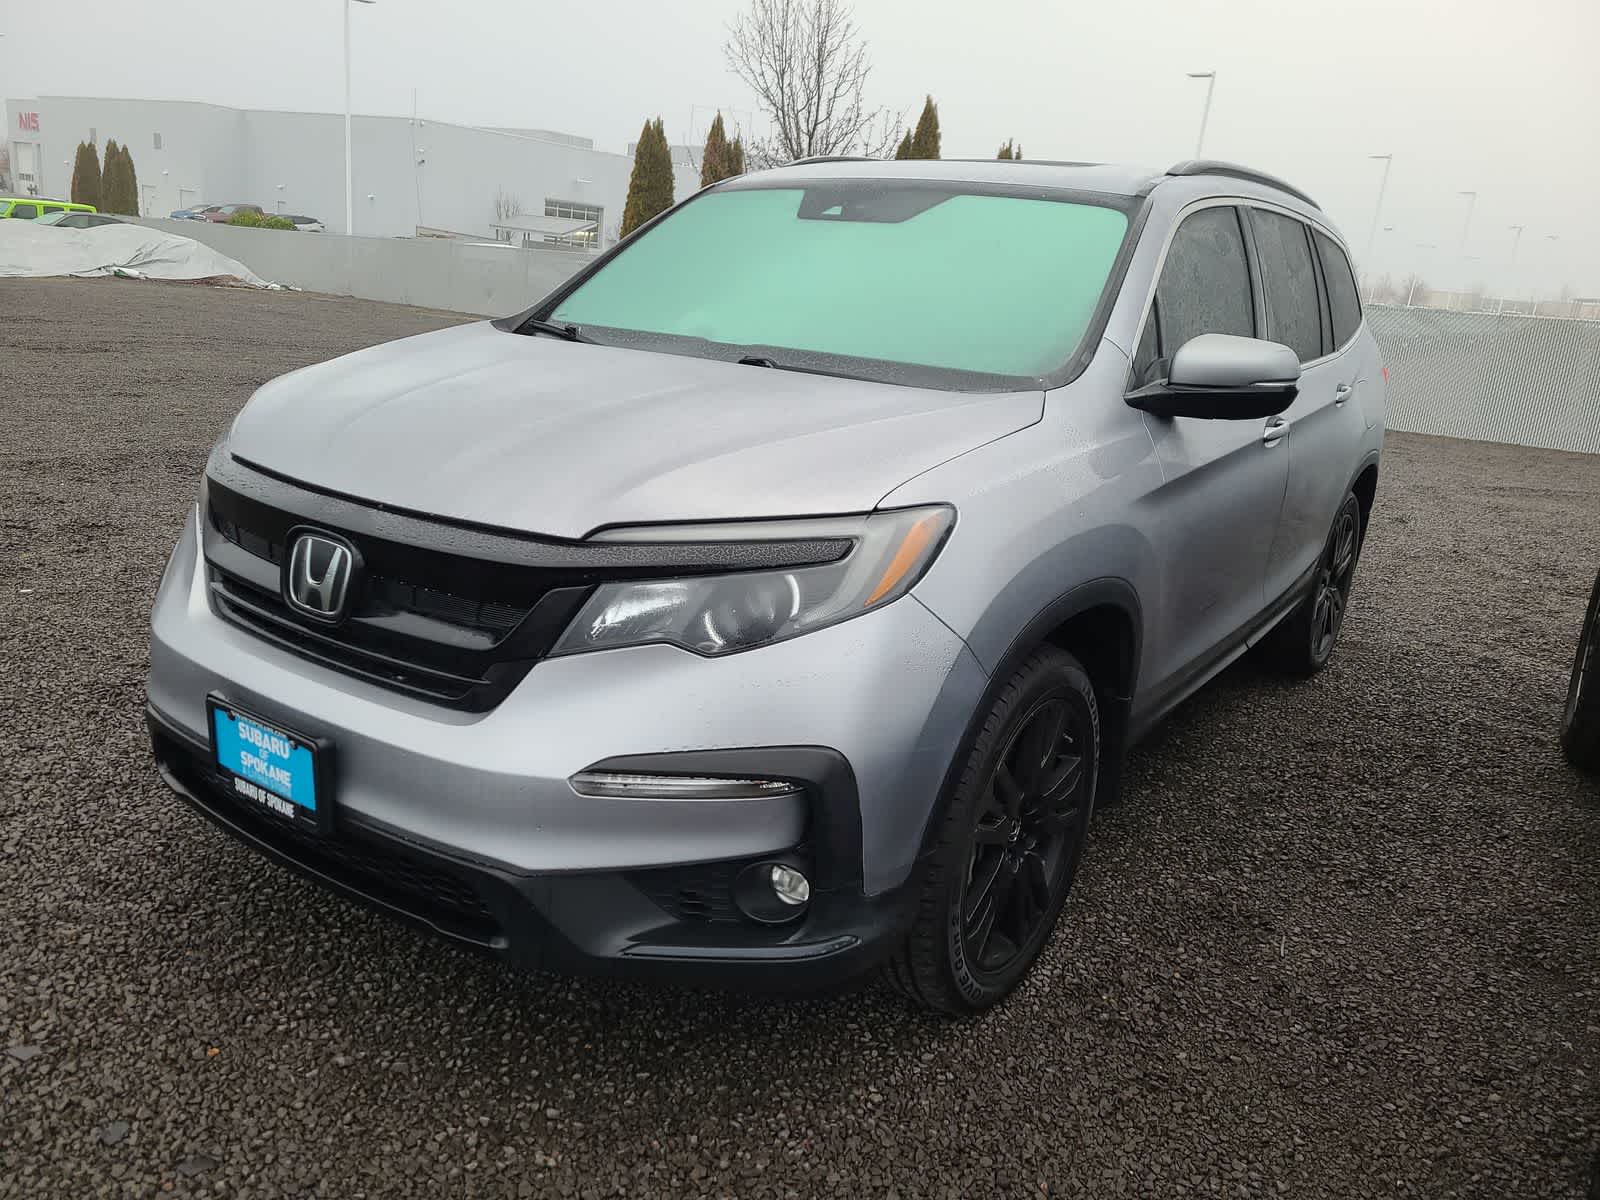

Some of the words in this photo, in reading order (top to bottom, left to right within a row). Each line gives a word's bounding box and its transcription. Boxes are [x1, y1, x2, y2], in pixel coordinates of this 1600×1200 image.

[238, 721, 289, 759] SUBARU
[240, 751, 292, 785] SPOKANE
[234, 777, 257, 800] SUBARU
[257, 788, 267, 804] OF
[266, 792, 295, 818] SPOKANE
